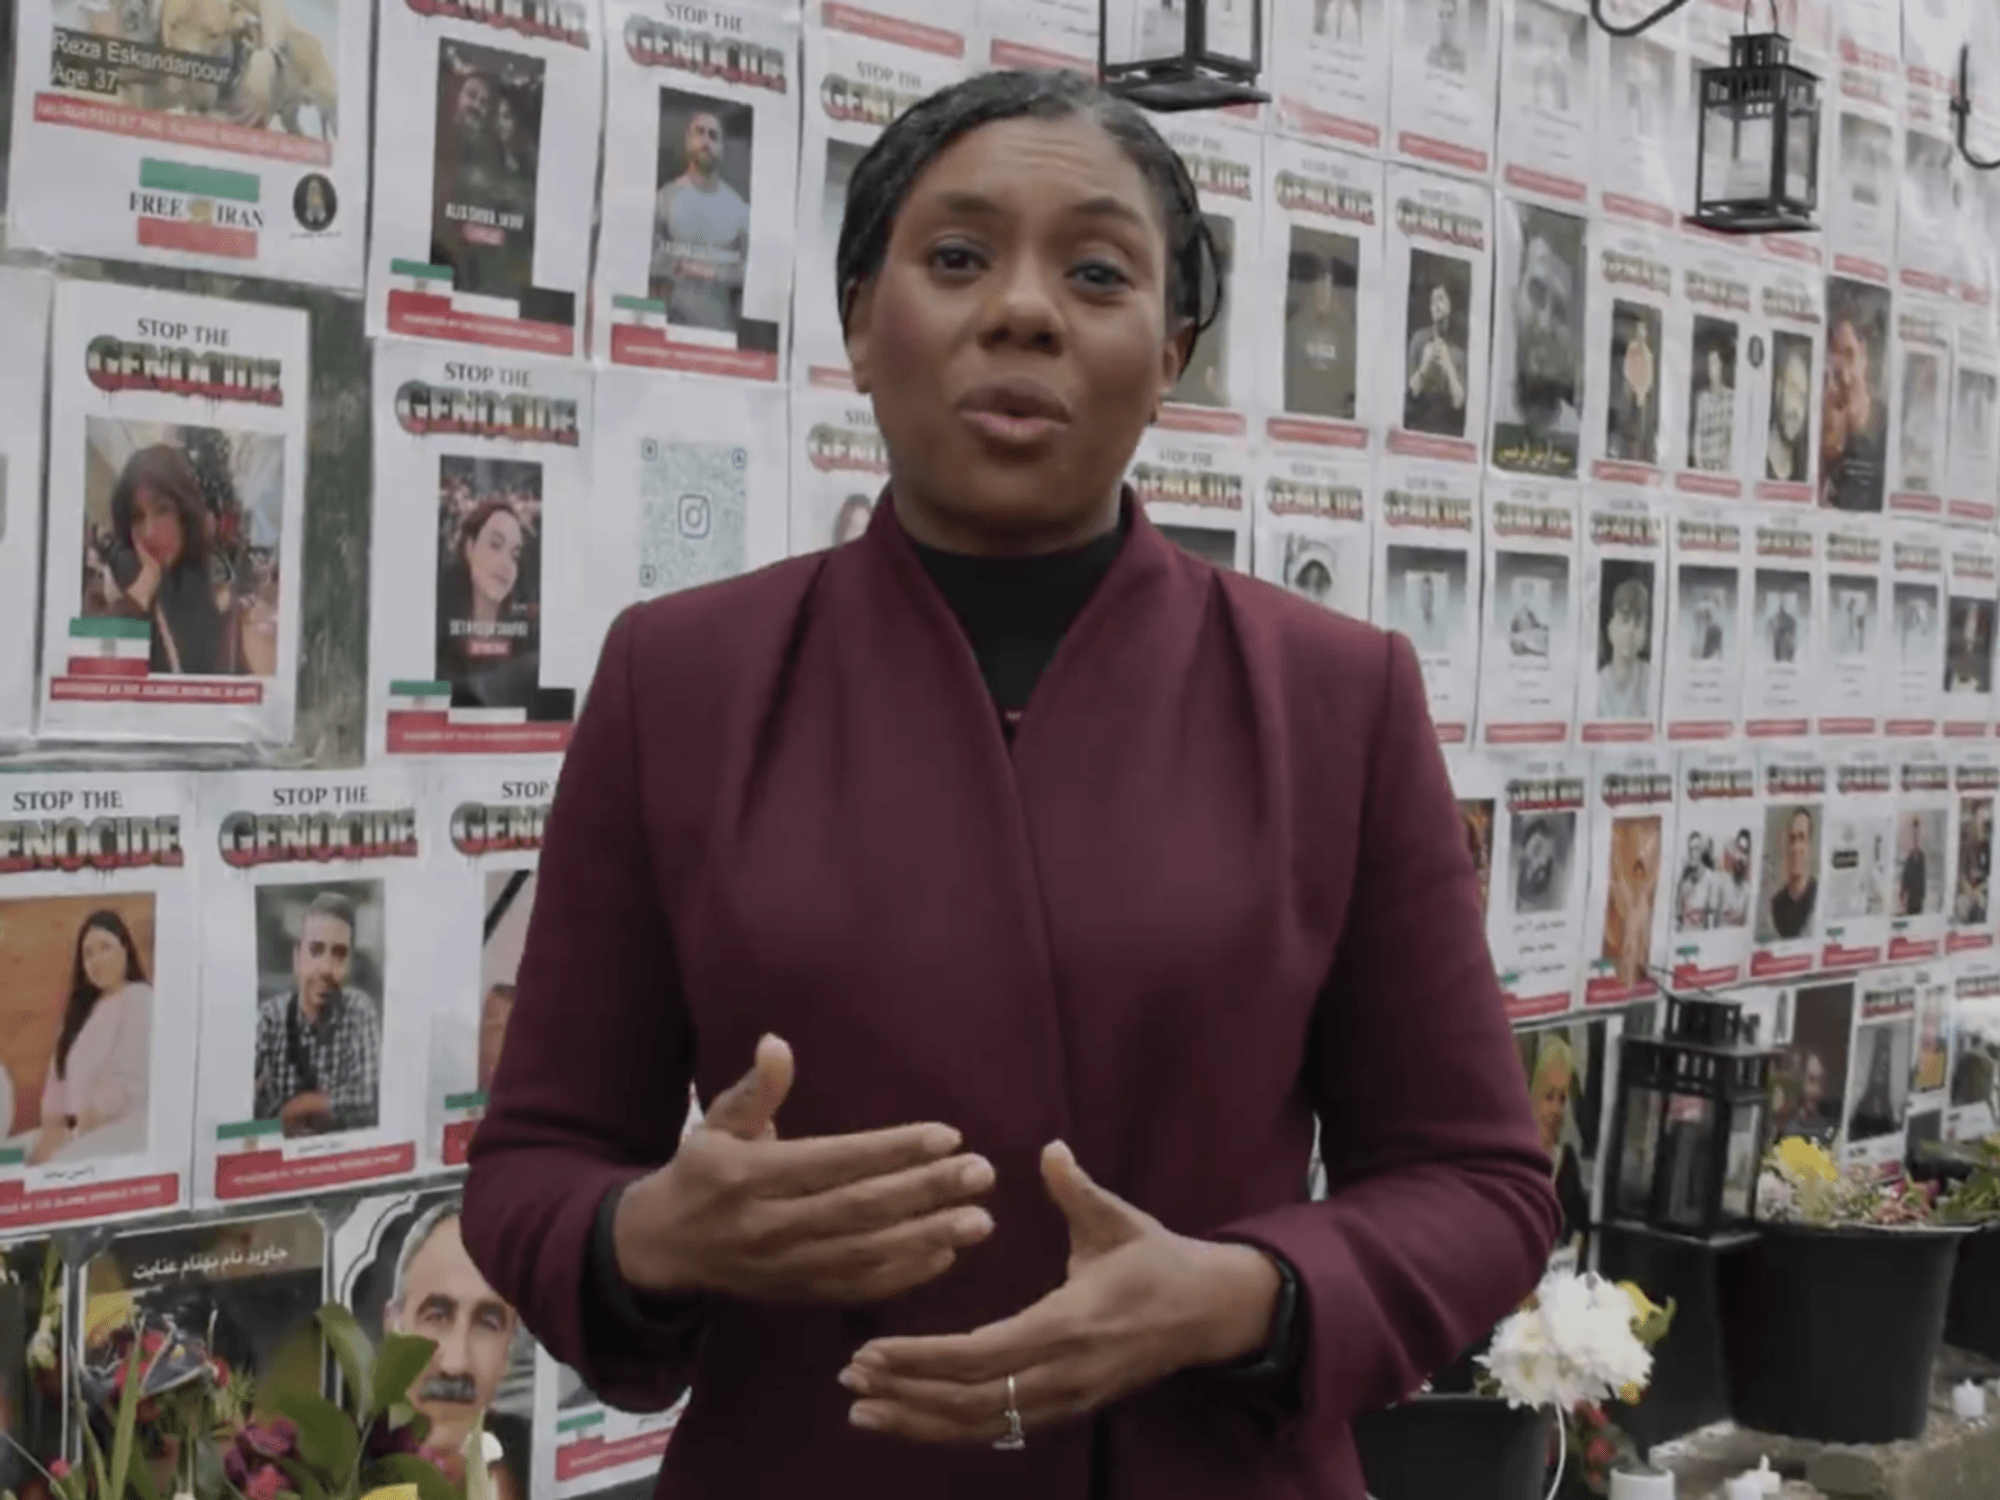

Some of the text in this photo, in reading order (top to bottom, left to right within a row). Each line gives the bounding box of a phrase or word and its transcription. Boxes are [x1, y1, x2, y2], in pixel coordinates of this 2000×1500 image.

[665, 2, 743, 33] STOP THE
[53, 32, 232, 83] Reza Eskandarpour
[51, 62, 119, 92] Age 37
[130, 192, 264, 228] FREE IRAN
[137, 318, 230, 347] STOP THE
[445, 362, 531, 388] STOP THE
[13, 791, 122, 811] STOP THE
[273, 786, 368, 806] STOP THE
[502, 781, 549, 799] STOP
[0, 815, 183, 873] ENOCIDE
